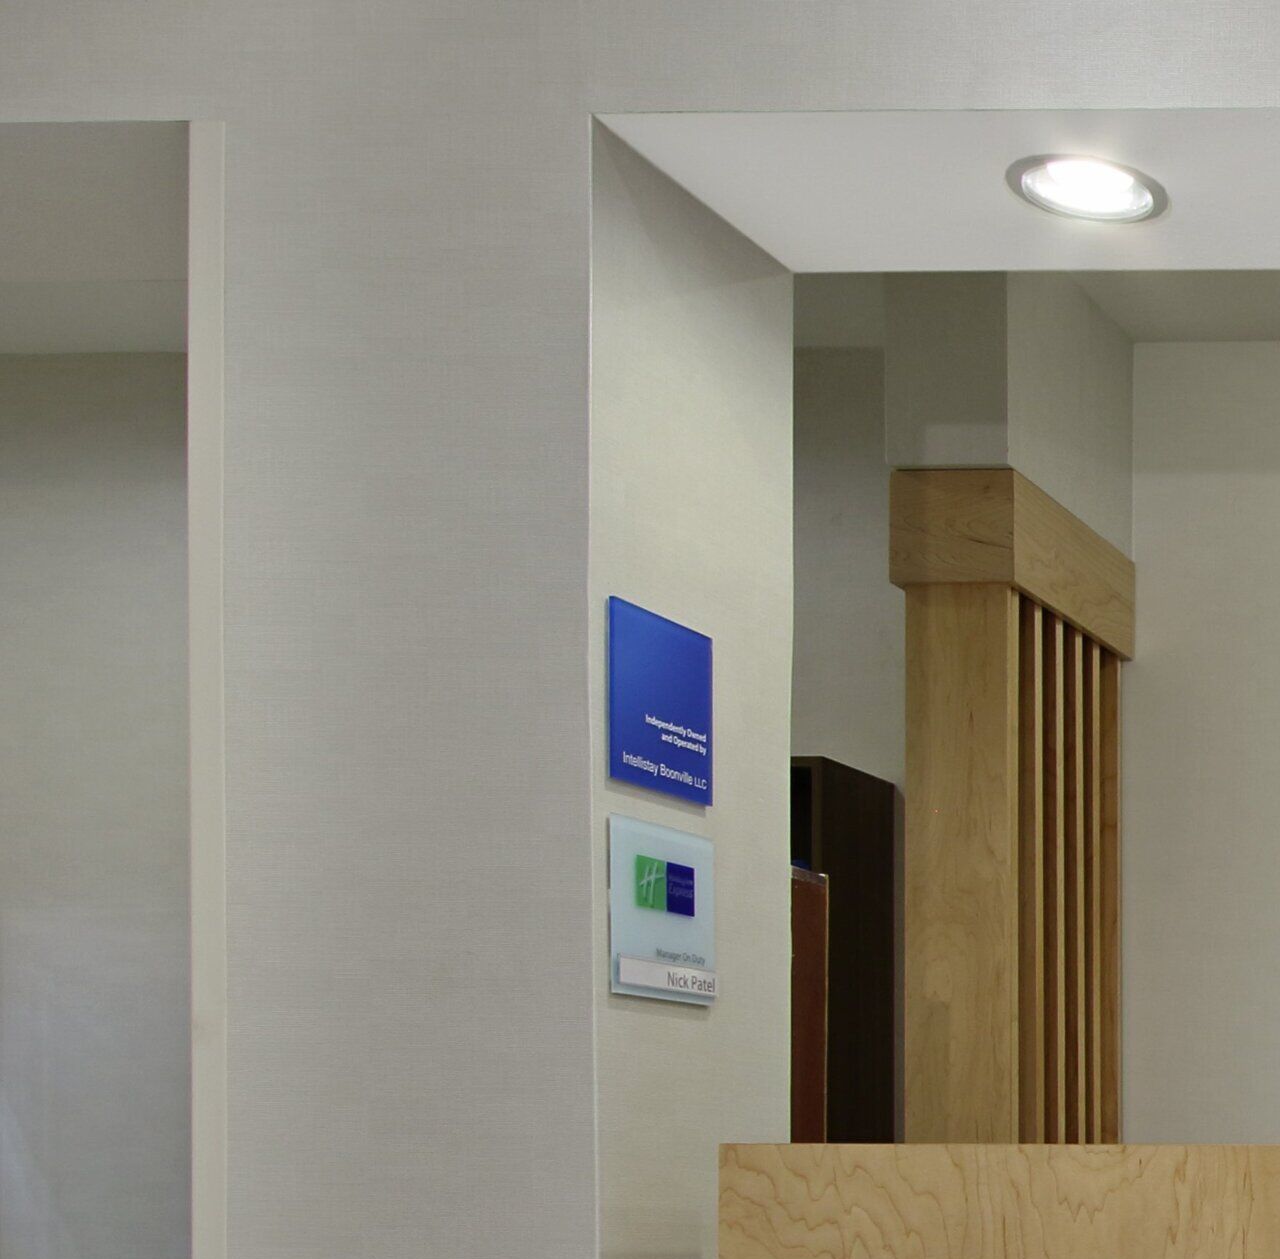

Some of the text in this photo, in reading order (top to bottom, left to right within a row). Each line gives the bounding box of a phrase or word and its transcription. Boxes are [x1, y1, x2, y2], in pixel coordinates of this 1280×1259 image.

[645, 714, 707, 742] Independently Owned
[661, 733, 707, 756] and Operated by
[623, 751, 707, 790] Intellistay Boonville LLC
[667, 971, 716, 993] Nick Patel
